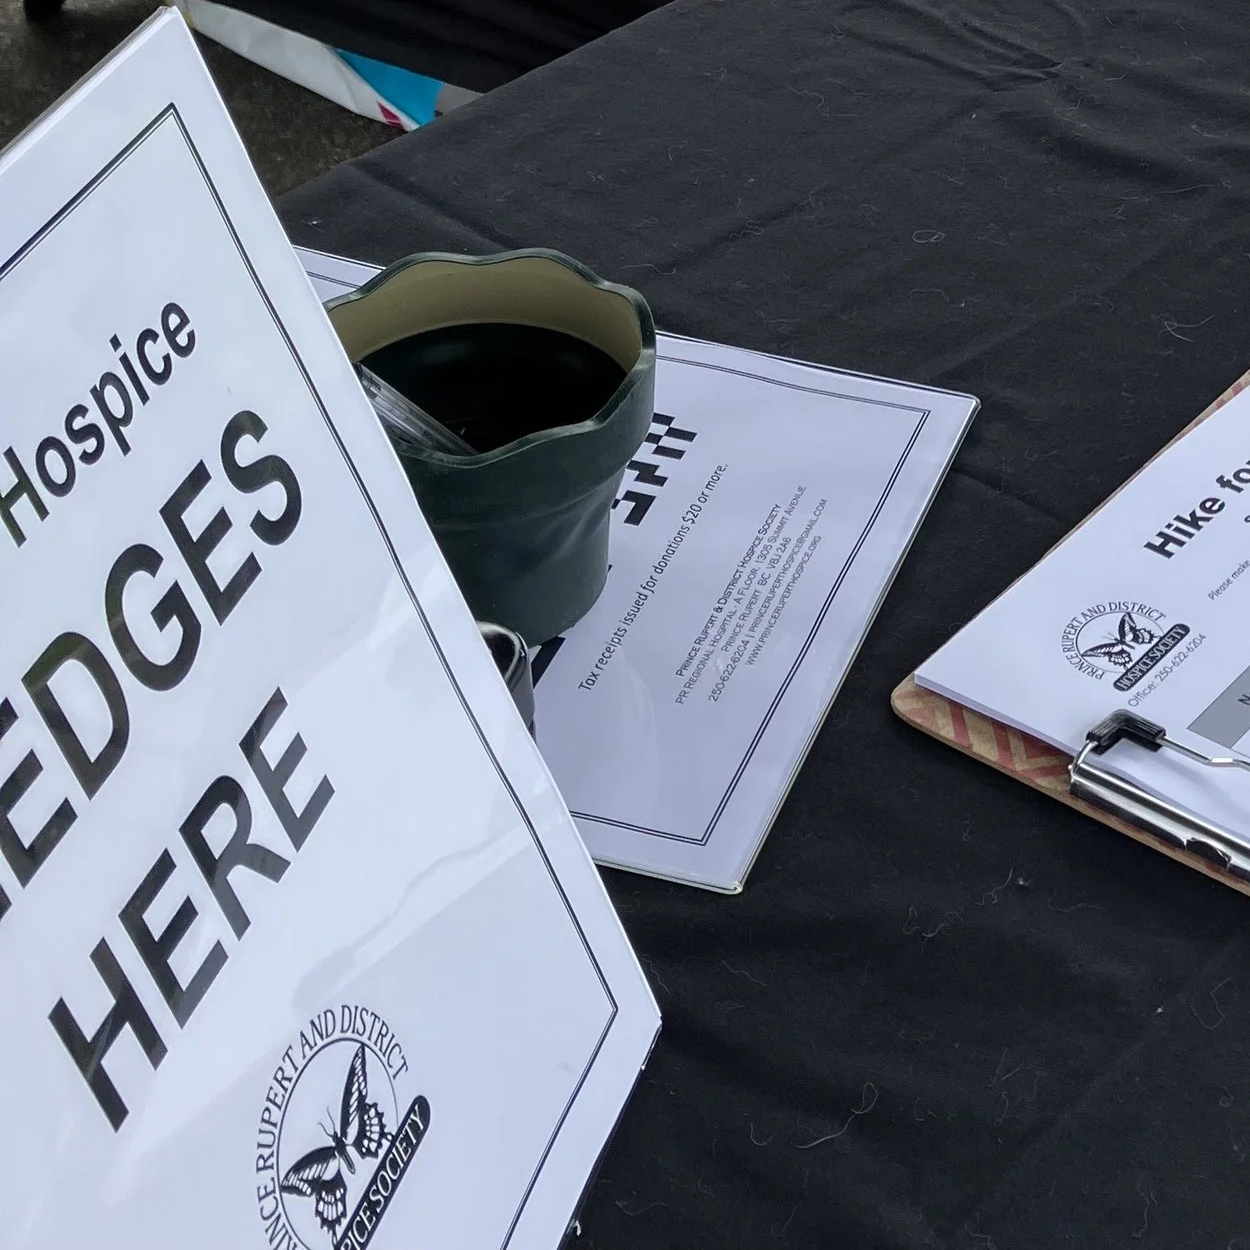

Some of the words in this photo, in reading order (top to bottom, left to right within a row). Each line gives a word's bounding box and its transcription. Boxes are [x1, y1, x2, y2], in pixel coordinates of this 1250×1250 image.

[0, 301, 196, 549] Hospice
[736, 534, 765, 569] HOSPICE
[757, 503, 782, 536] SOCIETY
[1143, 496, 1226, 560] Hike
[577, 670, 601, 691] Tax
[594, 626, 628, 671] receipts
[618, 591, 649, 627] issued
[639, 574, 659, 595] for
[651, 524, 691, 575] donations
[681, 503, 703, 525] $20
[697, 490, 710, 504] or
[704, 464, 729, 492] more.
[674, 689, 691, 705] PR
[683, 649, 716, 690] REGIONAL
[707, 609, 738, 651] HOSPITAL
[754, 541, 774, 564] 1305
[766, 515, 789, 544] SUMMIT
[783, 485, 807, 517] AVENUE
[712, 605, 724, 614] &
[716, 567, 745, 606] DISTRICT
[720, 621, 746, 653] PRINCE
[737, 587, 763, 625] RUPERT
[756, 571, 772, 587] BC
[775, 536, 792, 554] 2A6
[1207, 577, 1234, 602] Please
[693, 613, 719, 646] RUPERT
[1061, 617, 1083, 654] RUPERT
[1080, 604, 1106, 622] AND
[1108, 601, 1167, 623] DISTRICT
[0, 410, 302, 923] EDGES
[674, 645, 701, 677] PRINCE
[1065, 654, 1106, 681] PRINCE
[1117, 655, 1151, 690] HOSPICE
[1149, 625, 1186, 661] SOCIETY
[1127, 680, 1160, 707] Office:
[1154, 633, 1207, 682] 250-622-6204
[48, 687, 336, 1134] HERE
[299, 1009, 337, 1060] AND
[340, 1004, 409, 1081] DISTRICT
[256, 1046, 300, 1174] RUPERT
[369, 1104, 425, 1214] SOCIETY
[256, 1177, 298, 1250] INCE
